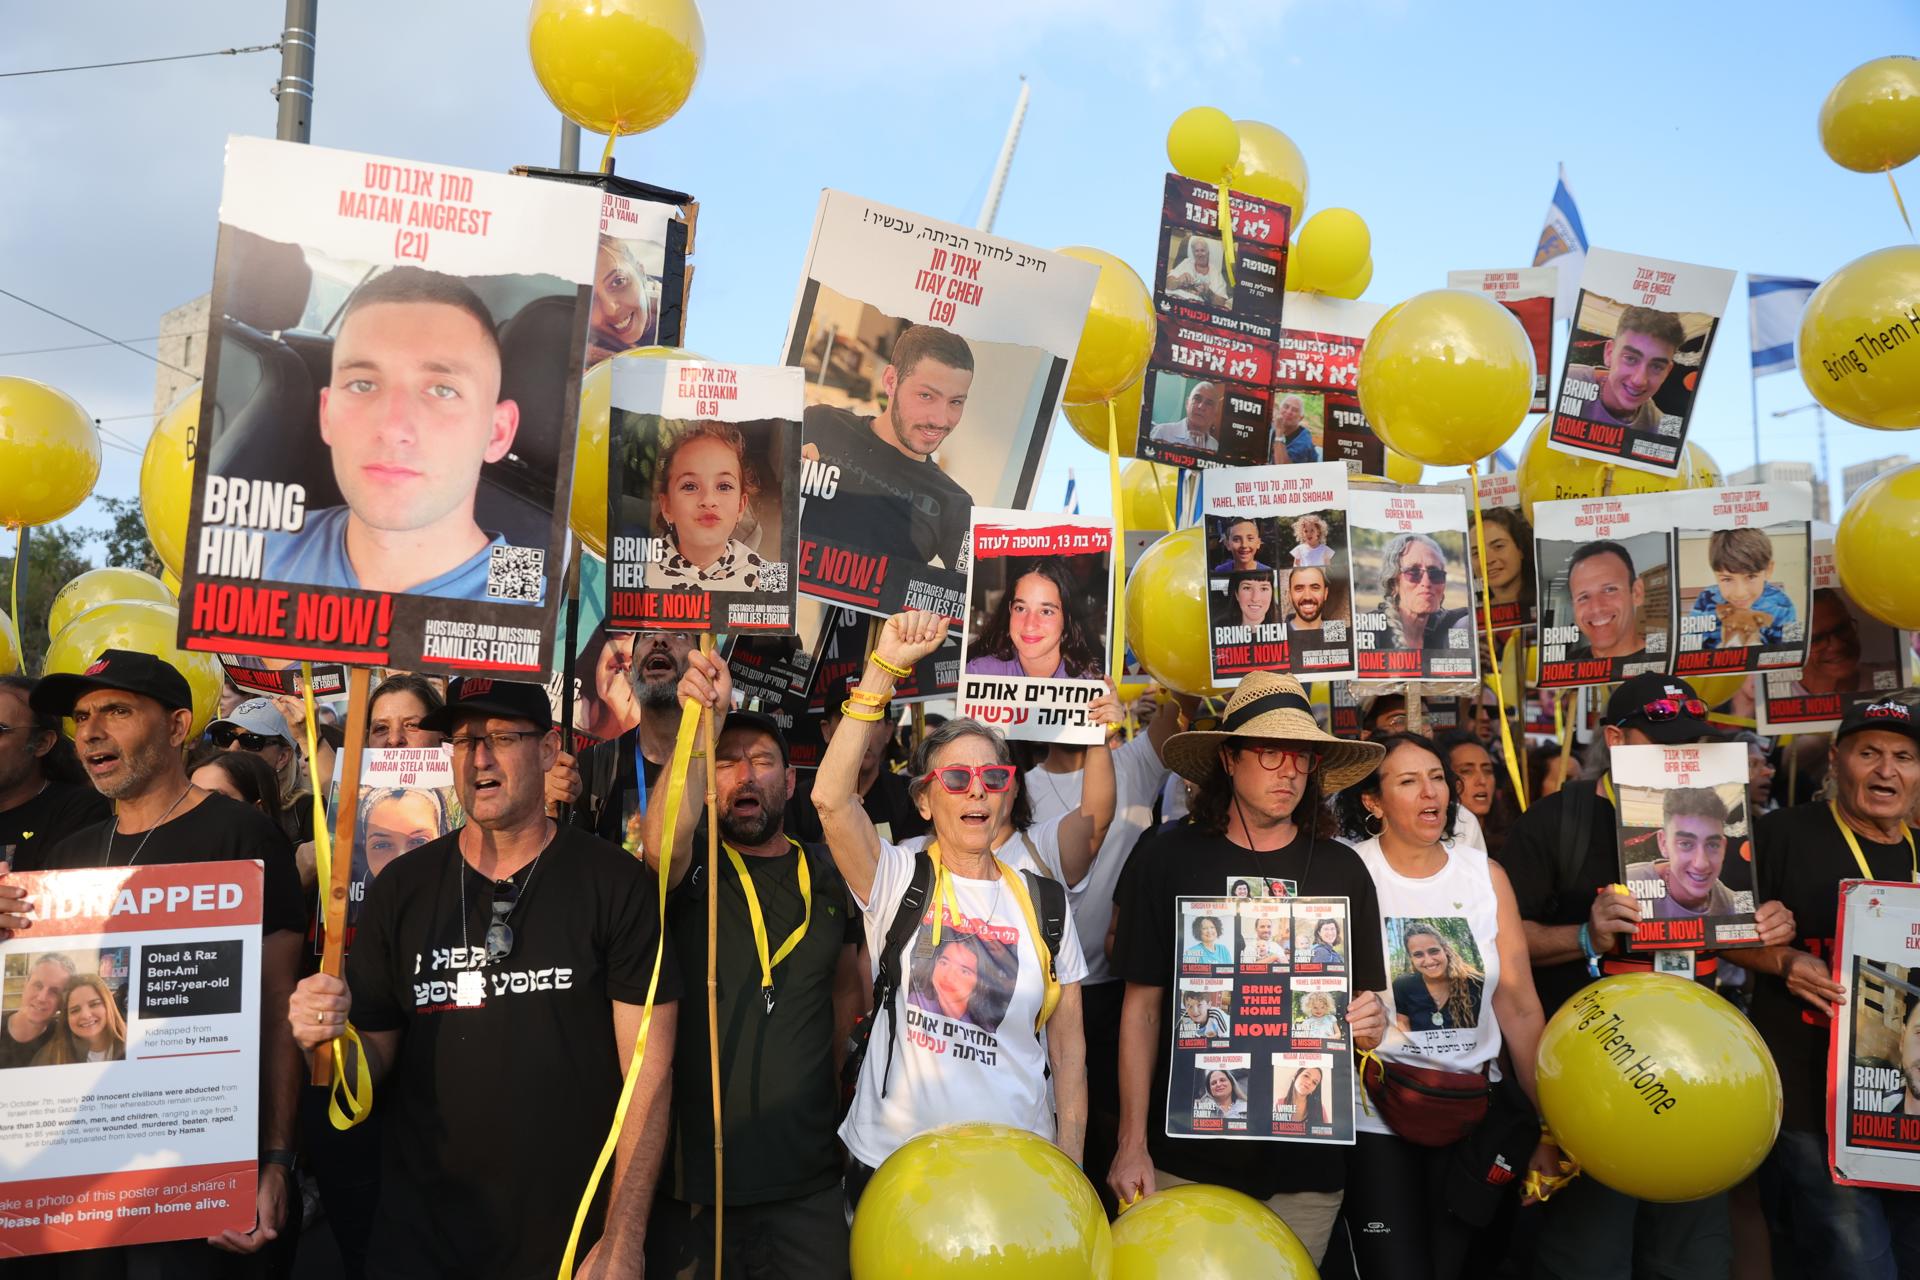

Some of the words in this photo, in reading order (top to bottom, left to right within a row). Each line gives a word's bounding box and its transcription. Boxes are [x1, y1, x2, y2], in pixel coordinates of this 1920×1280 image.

[364, 162, 432, 197] אנגרסט
[439, 172, 474, 203] מתן
[338, 191, 402, 224] MATAN
[407, 203, 492, 236] ANGREST
[616, 210, 638, 224] YANAI
[873, 212, 914, 234] עכשיו
[1243, 218, 1271, 241] לא
[394, 229, 429, 261] (21)
[974, 241, 1014, 263] לחזור
[930, 247, 947, 271] חן
[950, 256, 982, 281] איתי
[1016, 253, 1047, 273] חייב
[915, 269, 945, 294] ITAY
[948, 279, 983, 306] CHEN
[1651, 283, 1672, 296] ENGEL
[928, 298, 957, 327] (19)
[1171, 344, 1226, 373] איתנו
[1823, 349, 1867, 381] Bring
[1855, 324, 1911, 359] Them
[717, 369, 737, 383] אלה
[1229, 358, 1258, 380] לא
[679, 385, 696, 398] ELA
[698, 385, 738, 400] ELYAKIM
[1563, 378, 1599, 401] BRING
[696, 401, 719, 417] (8.5)
[1559, 396, 1583, 417] HIM
[1556, 415, 1587, 438] HOME
[1589, 422, 1624, 446] NOW!
[202, 475, 305, 532] BRING
[1212, 496, 1235, 509] YAHEL,
[1237, 495, 1257, 508] NEVE,
[1258, 494, 1271, 506] TAL
[1272, 493, 1287, 505] AND
[1288, 492, 1301, 504] ADI
[1302, 491, 1333, 503] SHOHAM
[1405, 510, 1424, 520] MAYA
[1595, 513, 1630, 525] YAHALOMI
[613, 536, 663, 563] BRING
[979, 534, 1009, 550] לעזה
[1012, 535, 1050, 548] נחטפה
[1052, 534, 1071, 550] 13,
[1073, 534, 1089, 547] בת
[1092, 534, 1108, 547] גלי
[197, 527, 266, 580] HIM
[613, 563, 645, 589] HER
[817, 545, 889, 594] NOW!
[909, 579, 945, 598] HOSTAGES
[943, 588, 958, 602] AND
[612, 591, 659, 618] HOME
[662, 592, 711, 620] NOW!
[729, 604, 755, 613] HOSTAGES
[756, 604, 766, 613] AND
[767, 605, 790, 614] MISSING
[905, 591, 950, 616] FAMILIES
[192, 583, 289, 637] HOME
[296, 593, 394, 648] NOW!
[728, 612, 760, 624] FAMILIES
[762, 613, 789, 625] FORUM
[1355, 613, 1387, 632] BRING
[1681, 614, 1716, 634] BRING
[426, 619, 476, 641] HOSTAGES
[477, 624, 498, 642] AND
[498, 627, 541, 645] MISSING
[1215, 627, 1253, 646] BRING
[1255, 623, 1288, 643] THEM
[1355, 632, 1375, 650] HER
[1543, 625, 1579, 645] BRING
[1680, 633, 1702, 652] HIM
[423, 635, 487, 663] FAMILIES
[489, 640, 540, 667] FORUM
[1215, 645, 1252, 665] HOME
[1254, 640, 1290, 663] NOW!
[1388, 649, 1422, 670] NOW!
[1543, 645, 1566, 663] HIM
[1677, 650, 1711, 669] HOME
[1713, 646, 1747, 666] NOW!
[1543, 662, 1575, 681] HOME
[1578, 657, 1612, 677] NOW!
[253, 671, 283, 689] NOW!
[320, 679, 340, 689] FORUM
[966, 682, 1019, 701] אותם
[1025, 684, 1104, 704] מחזירים
[1770, 699, 1802, 716] HOME
[1806, 694, 1841, 714] NOW!
[421, 750, 439, 761] מורן
[369, 761, 398, 772] MORAN
[399, 761, 424, 773] STELA
[425, 761, 449, 772] YANAI
[1681, 761, 1701, 772] ENGEL
[399, 773, 416, 785] (40)
[1627, 879, 1667, 899] BRING
[1669, 917, 1705, 940] NOW!
[148, 952, 180, 963] Ohad
[183, 951, 192, 961] &
[195, 950, 218, 961] Raz
[414, 953, 422, 975] I
[431, 945, 488, 971] HEA
[148, 965, 198, 978] Ben-Ami
[491, 966, 573, 996] VOICE
[147, 977, 229, 992] 54|57-year-old
[1242, 985, 1283, 994] BRING
[146, 994, 189, 1006] Israelis
[1243, 996, 1280, 1005] THEM
[907, 1009, 939, 1034] אותם
[1240, 1006, 1281, 1016] HOME
[145, 1026, 191, 1037] Kidnapped
[193, 1025, 212, 1033] from
[943, 1023, 998, 1048] מחזירים
[1234, 1023, 1287, 1036] NOW!
[145, 1039, 158, 1048] her
[160, 1038, 184, 1047] home
[185, 1037, 196, 1045] by
[198, 1035, 229, 1044] Hamas
[953, 1043, 997, 1066] הביתה
[1573, 990, 1605, 1030] Bring
[1593, 1014, 1636, 1066] Them
[1624, 1055, 1676, 1115] Home
[1854, 1065, 1900, 1091] BRING
[97, 1092, 129, 1101] innocent
[131, 1090, 163, 1099] civilians
[165, 1088, 183, 1096] were
[185, 1085, 220, 1095] abducted
[1853, 1088, 1882, 1112] HIM
[1852, 1113, 1896, 1138] HOME
[0, 1196, 21, 1211] ake
[24, 1199, 33, 1209] a
[36, 1192, 74, 1210] photo
[77, 1190, 90, 1204] of
[93, 1188, 116, 1202] this
[119, 1186, 159, 1202] poster
[163, 1182, 188, 1197] and
[191, 1179, 225, 1193] share
[228, 1177, 236, 1190] it
[43, 1211, 74, 1227] help
[77, 1207, 113, 1223] bring
[116, 1205, 151, 1218] them
[154, 1201, 192, 1214] home
[195, 1197, 230, 1211] alive.
